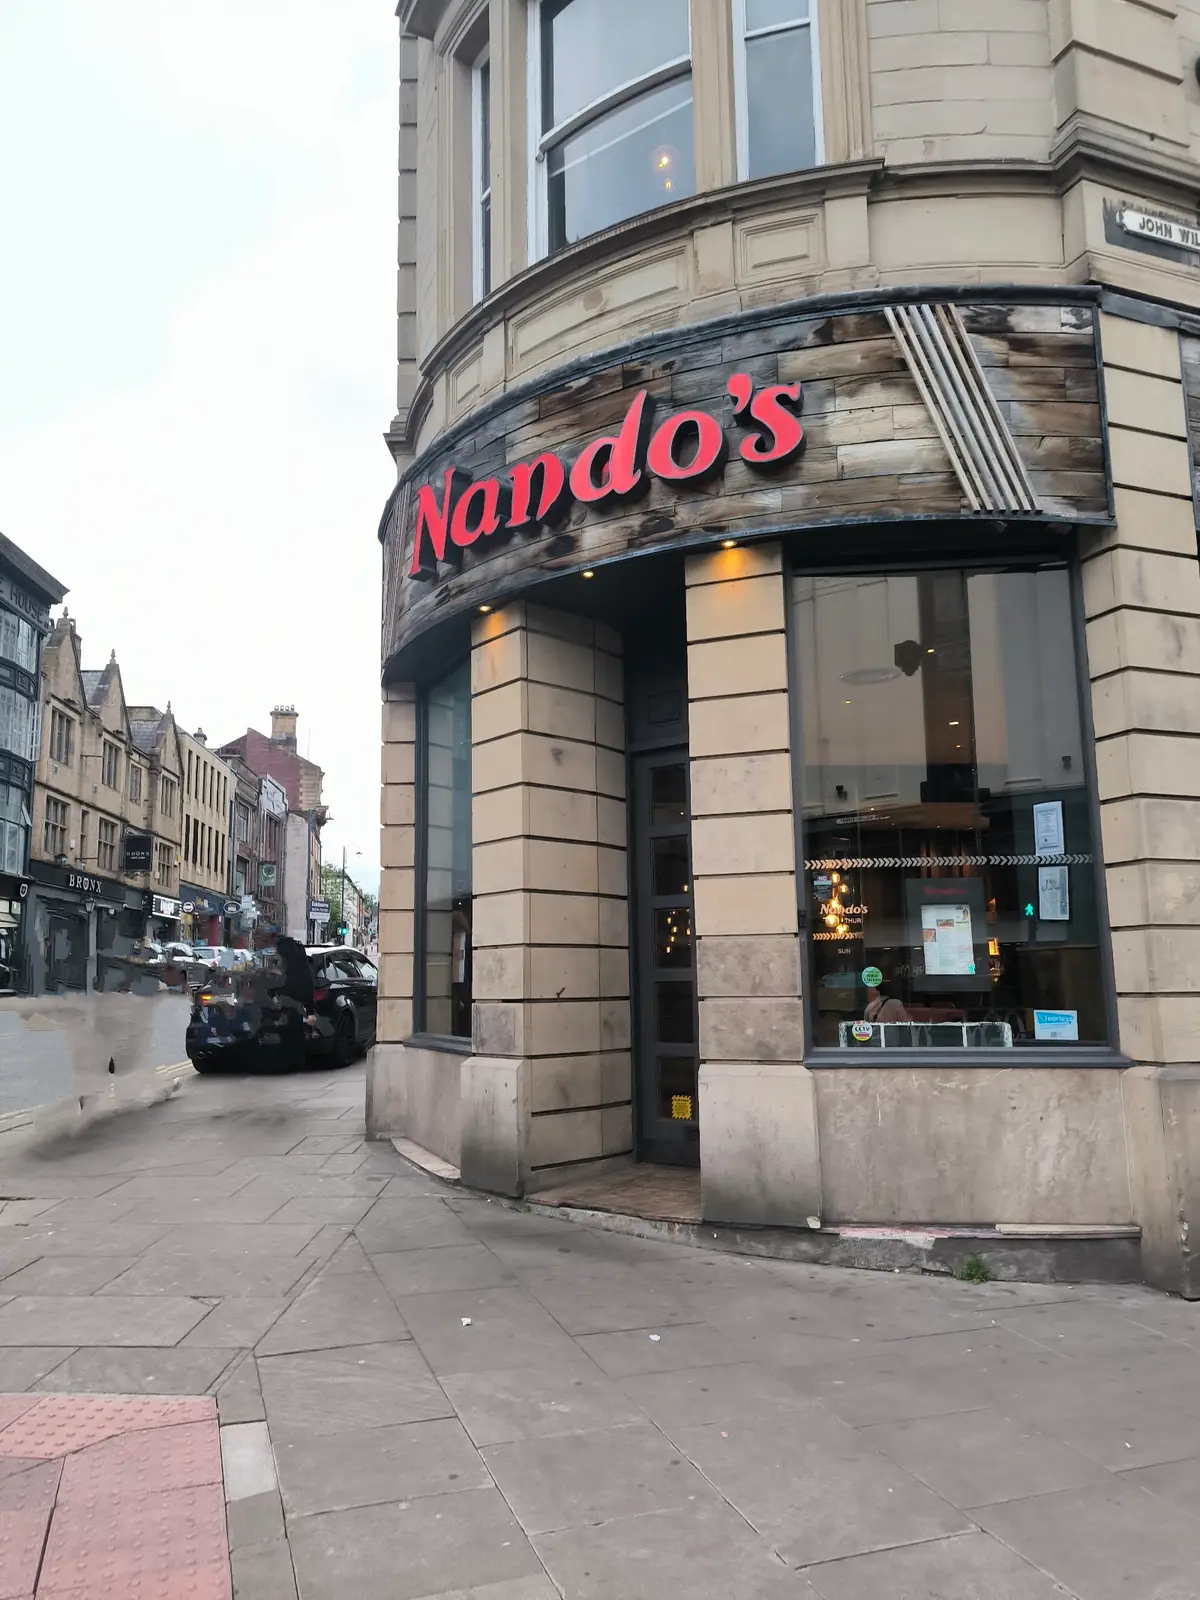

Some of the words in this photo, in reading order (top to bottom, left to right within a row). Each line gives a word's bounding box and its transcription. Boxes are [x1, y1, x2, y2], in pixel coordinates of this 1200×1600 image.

[1139, 217, 1173, 239] JOHN
[408, 373, 803, 579] Nando's
[69, 874, 102, 893] BRONX
